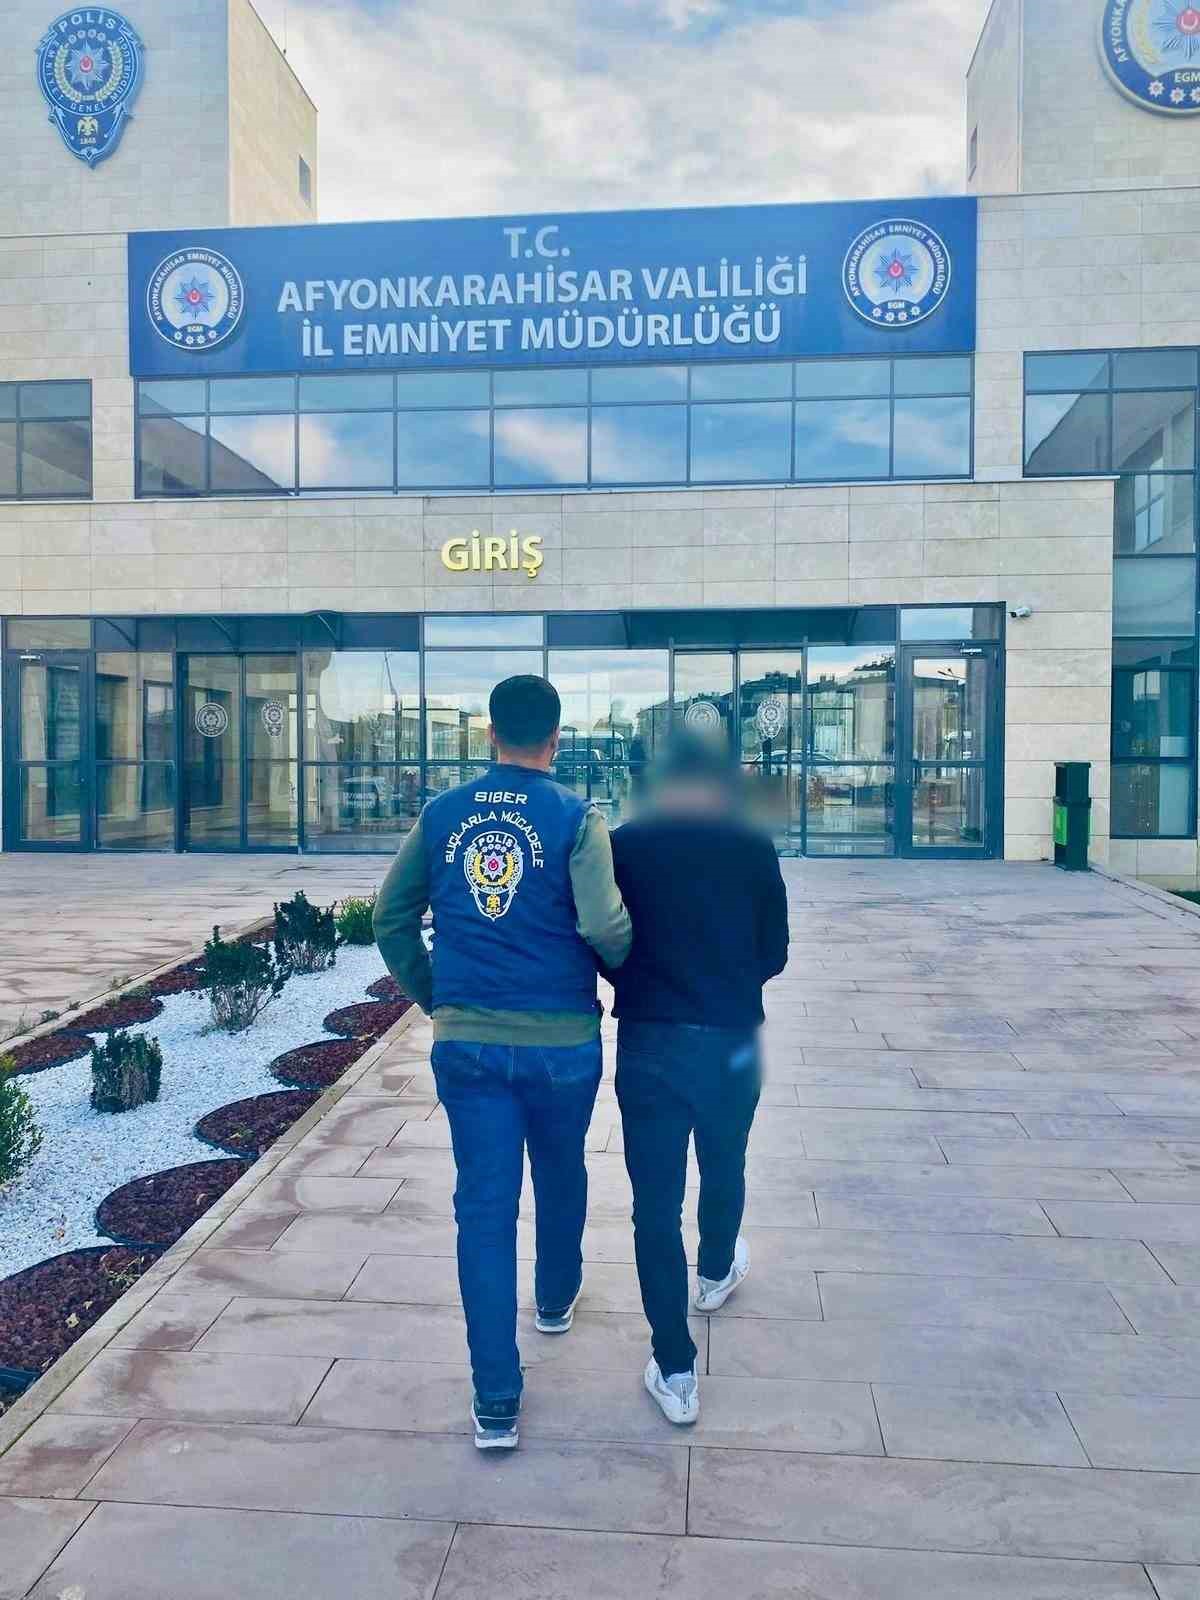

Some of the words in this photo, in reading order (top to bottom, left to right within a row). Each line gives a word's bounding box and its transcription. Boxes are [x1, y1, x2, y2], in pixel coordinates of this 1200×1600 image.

[1174, 72, 1200, 82] EGM
[503, 226, 570, 258] T.C.
[277, 265, 633, 312] AFYONKARAHİSAR
[641, 255, 808, 300] VALİLİĞİ
[302, 319, 334, 357] İL
[343, 314, 512, 356] EMNİYET
[520, 302, 782, 350] MÜDÜRLÜĞÜ
[441, 529, 544, 578] GİRİŞ
